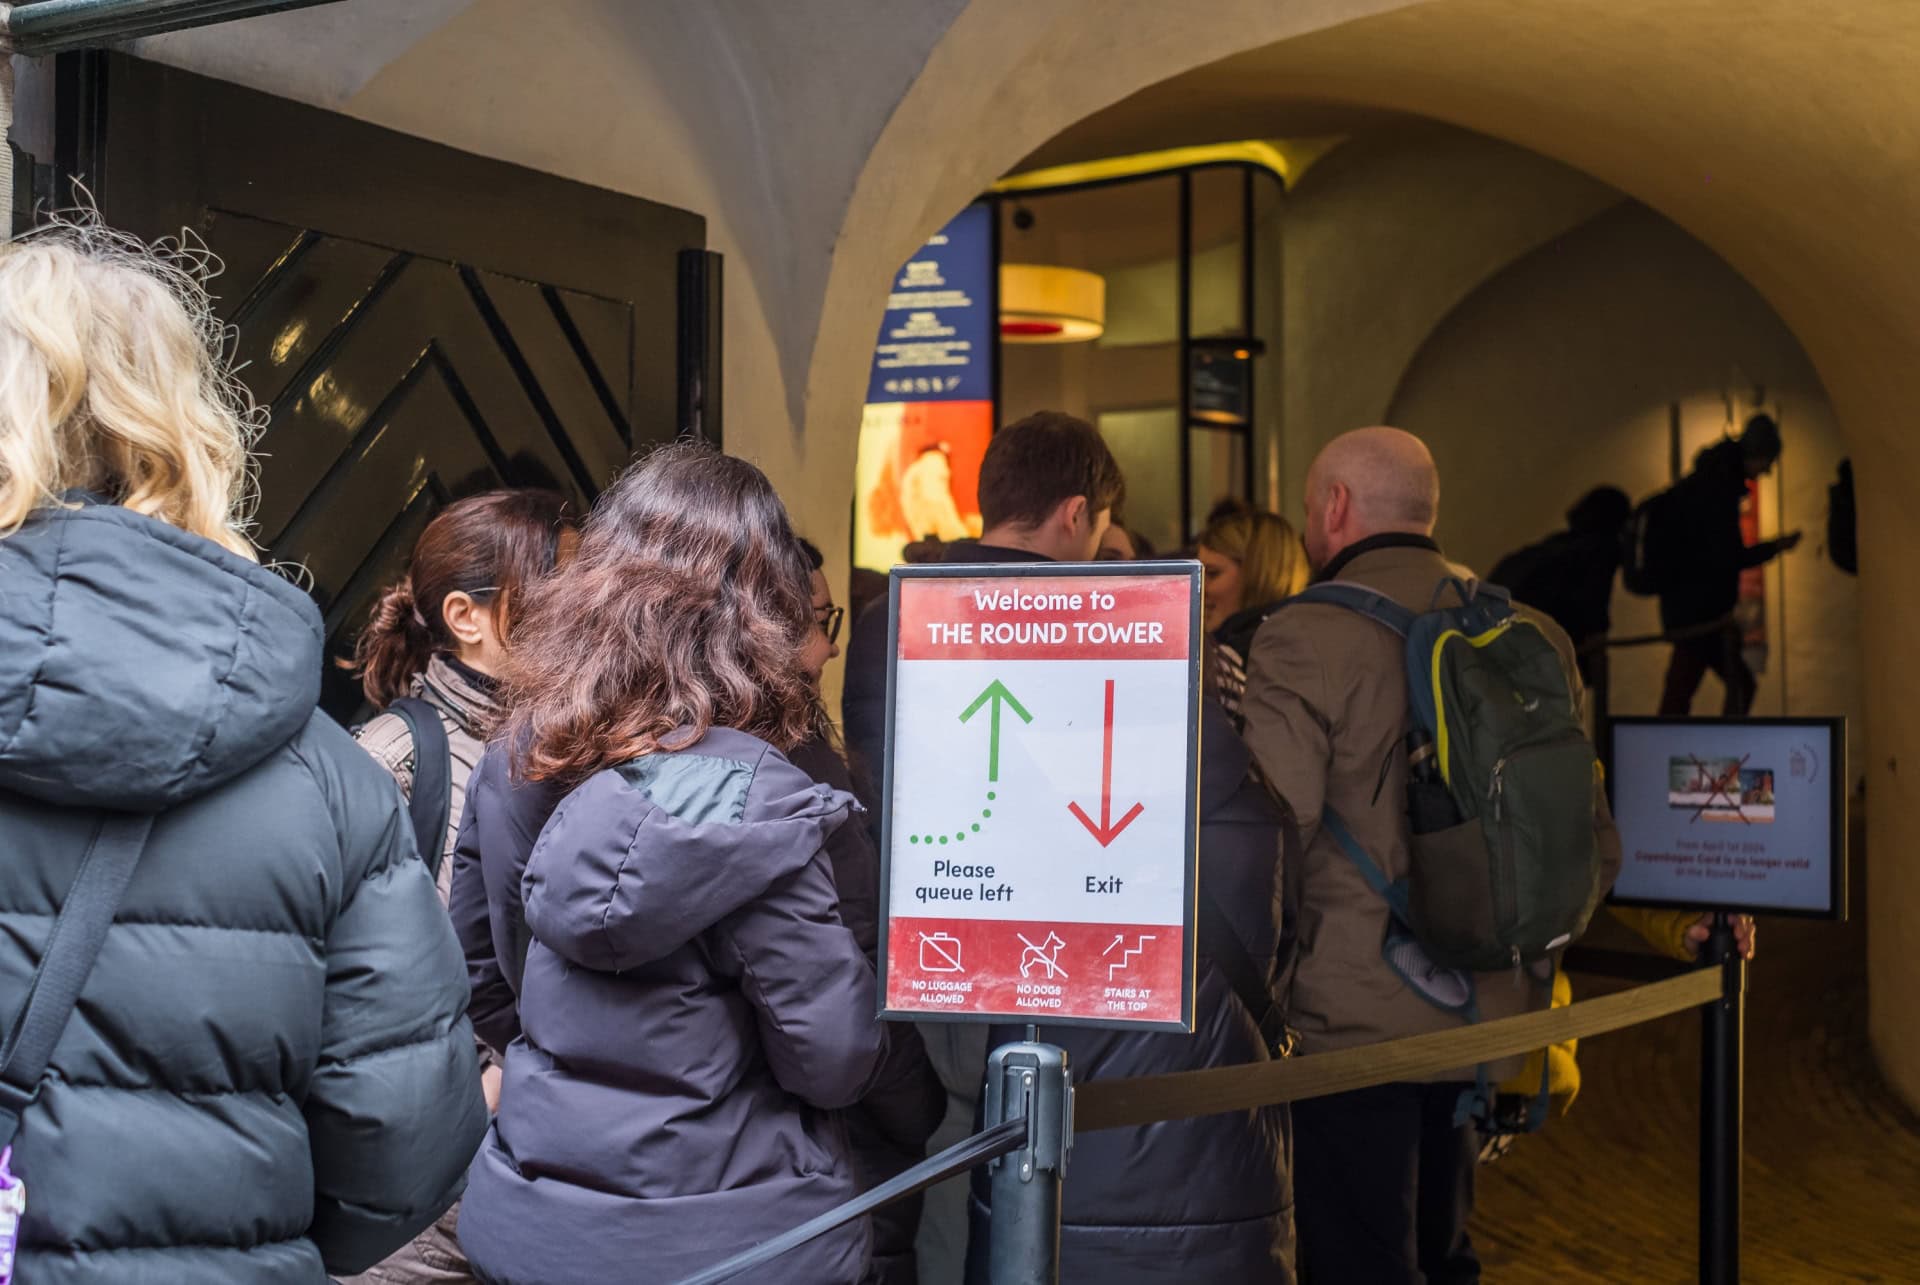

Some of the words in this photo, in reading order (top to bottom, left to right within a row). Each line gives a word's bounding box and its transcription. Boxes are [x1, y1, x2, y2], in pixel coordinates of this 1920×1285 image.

[974, 589, 1082, 611] Welcome
[1090, 590, 1115, 610] to
[927, 623, 973, 644] THE
[980, 622, 1067, 644] ROUND
[1073, 622, 1163, 644] TOWER
[933, 860, 995, 878] Please
[1085, 875, 1123, 894] Exit
[915, 886, 973, 903] queue
[979, 884, 1014, 902] left
[912, 980, 926, 990] NO
[928, 981, 972, 993] LUGGAGE
[1016, 984, 1030, 995] NO
[1033, 985, 1061, 996] DOGS
[919, 993, 964, 1004] ALLOWED
[1103, 987, 1136, 999] STAIRS
[1138, 989, 1152, 1000] AT
[1015, 997, 1062, 1008] ALLOWED
[1106, 1000, 1126, 1010] THE
[1127, 1001, 1149, 1012] TOP
